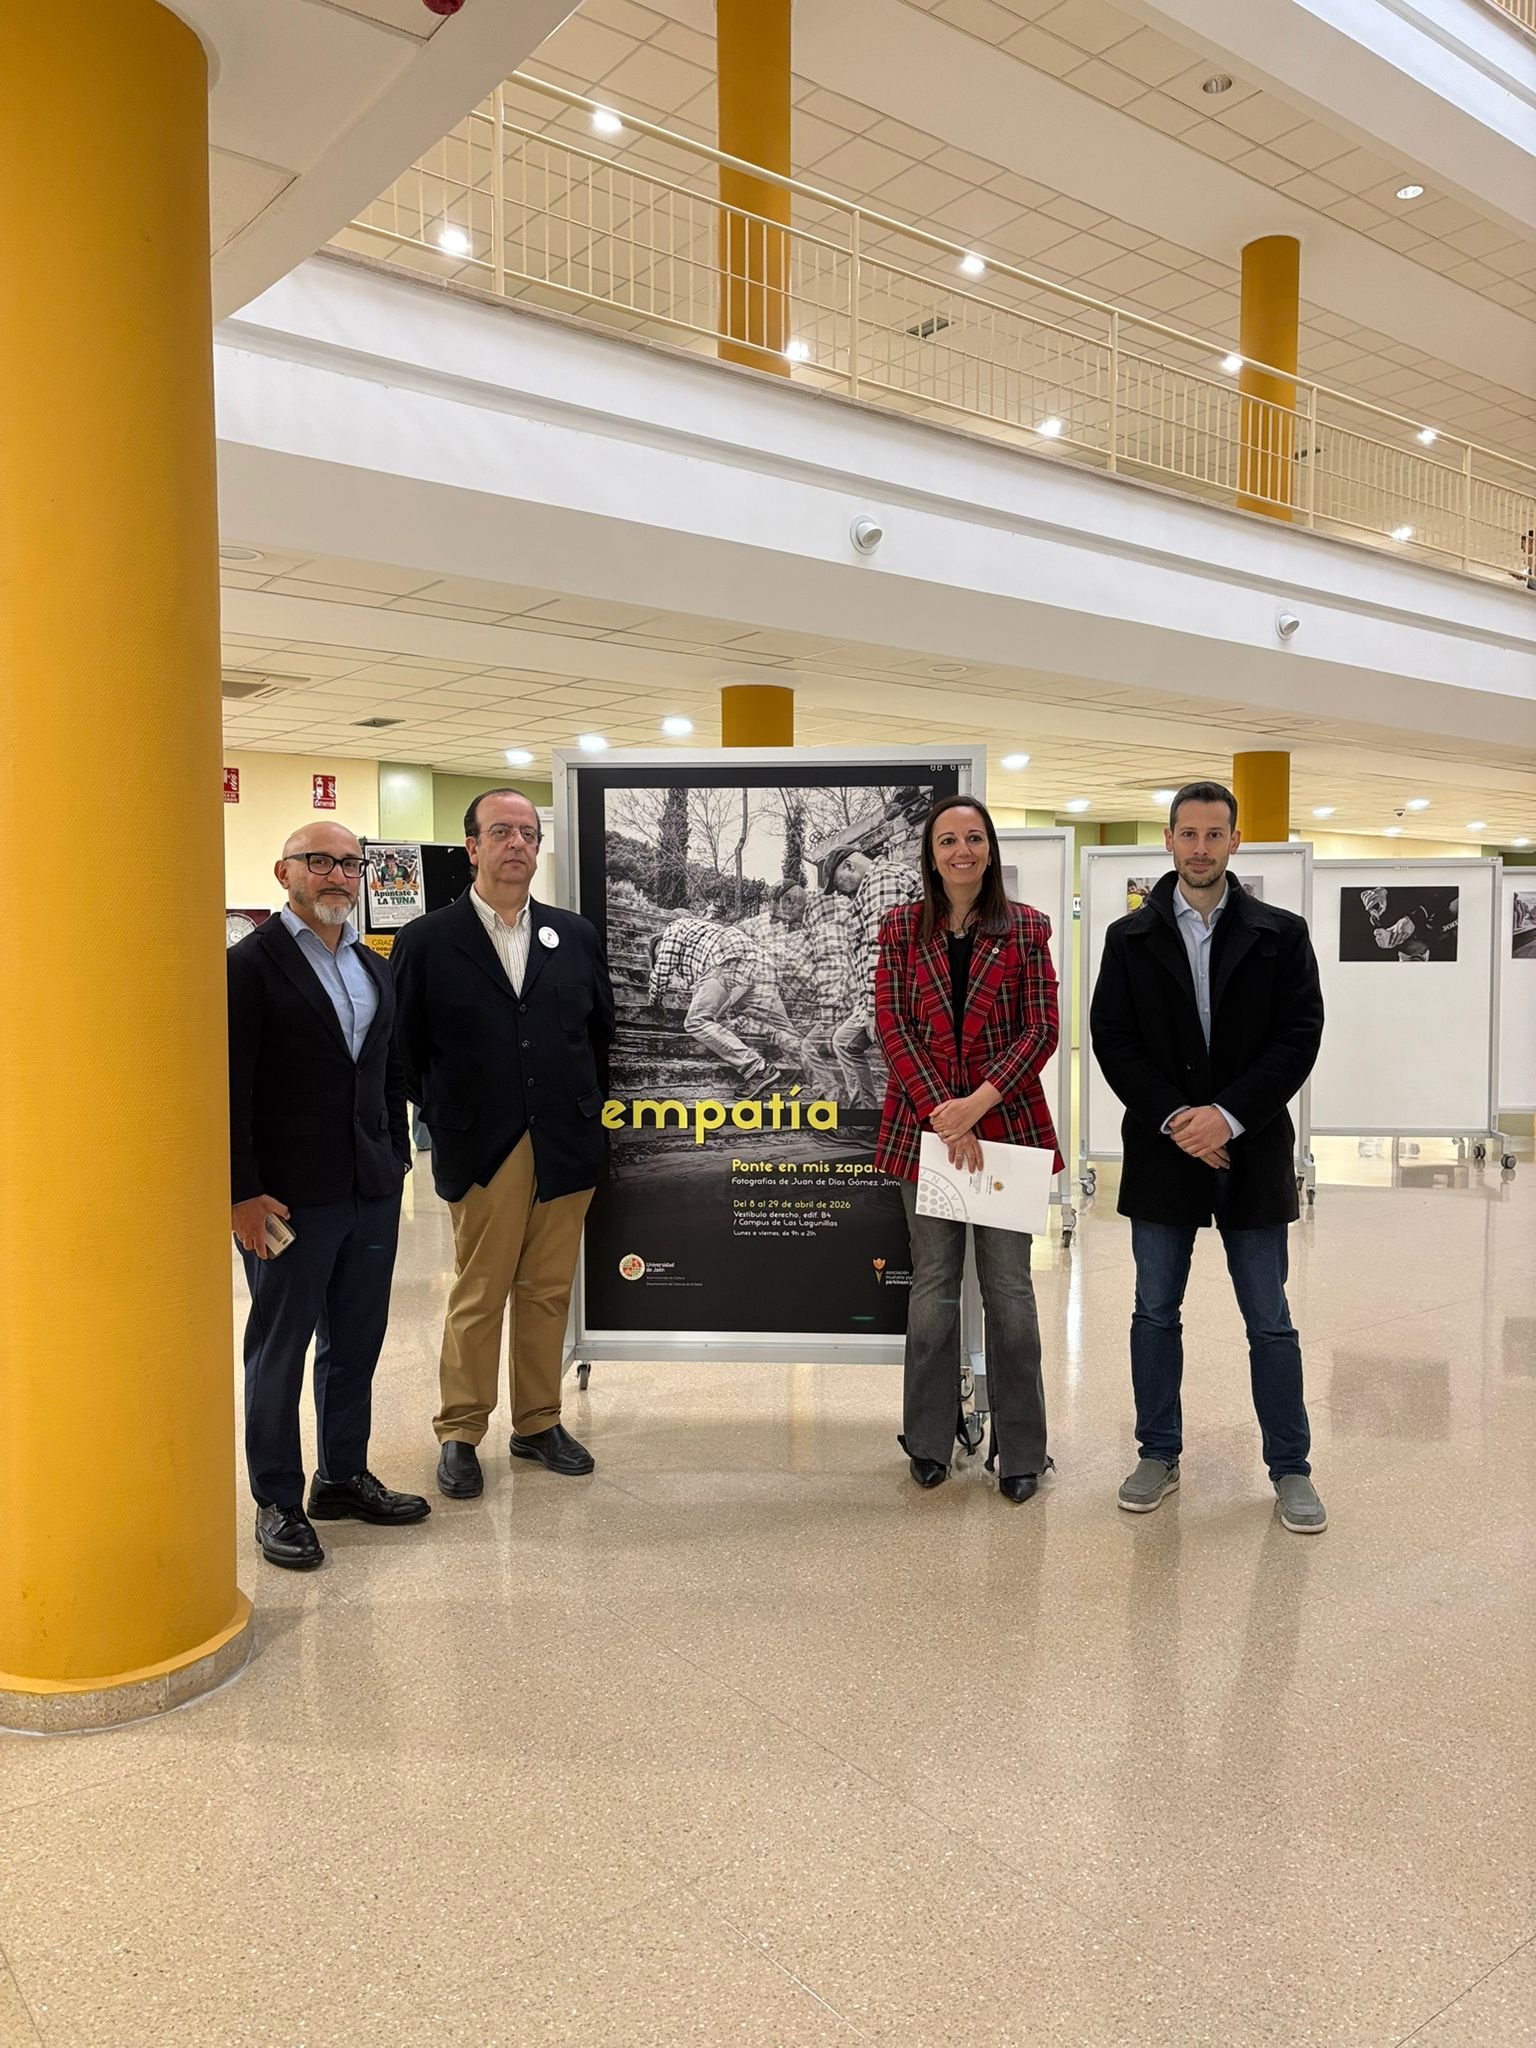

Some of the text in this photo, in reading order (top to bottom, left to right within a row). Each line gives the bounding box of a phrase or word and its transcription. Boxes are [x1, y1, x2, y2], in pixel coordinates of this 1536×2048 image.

[601, 1085, 838, 1144] empatía
[732, 1159, 773, 1172] Ponte
[779, 1163, 797, 1172] en
[803, 1160, 830, 1173] mis
[779, 1177, 789, 1185] de
[828, 1178, 845, 1186] Dios
[847, 1178, 878, 1186] Gómez
[733, 1199, 851, 1209] Del 8 al 29 de abril de 2026
[820, 1211, 832, 1219] B4
[738, 1218, 770, 1228] Campus
[798, 1219, 838, 1228] Lagunillas
